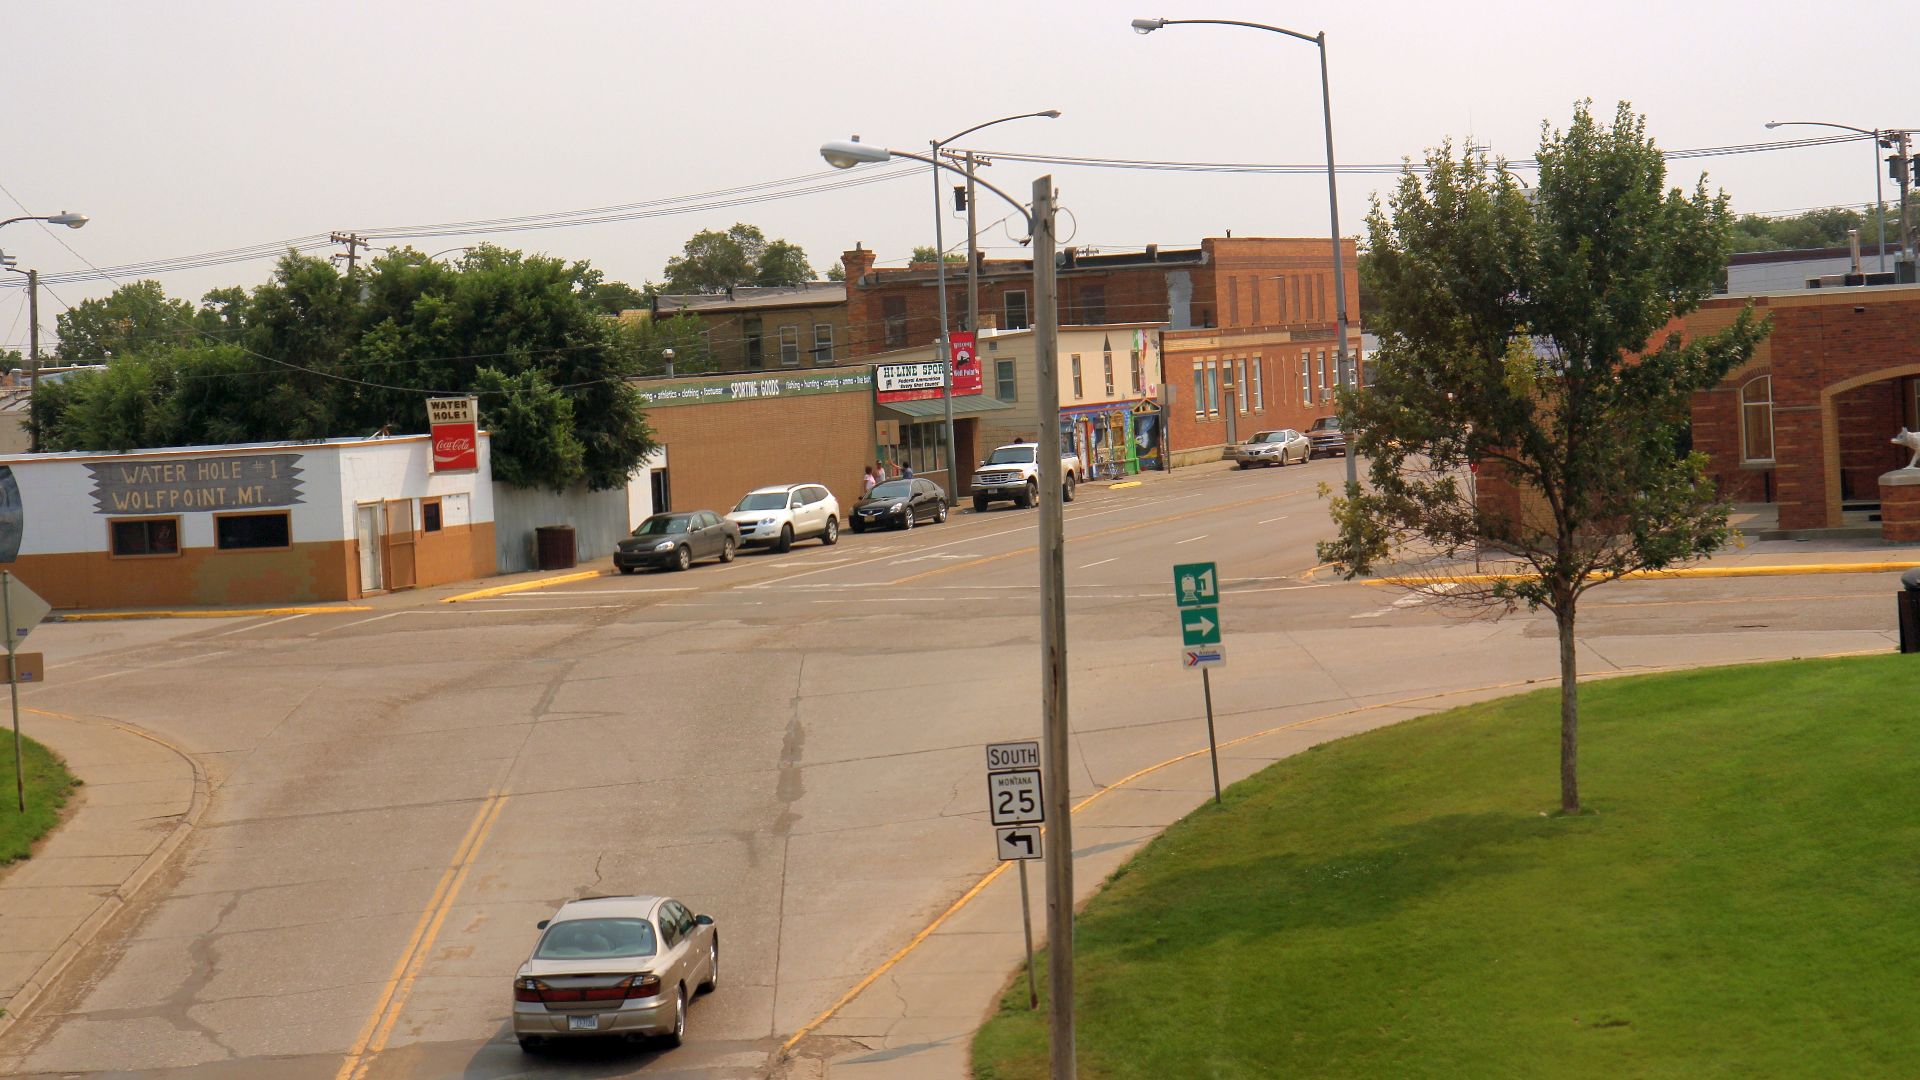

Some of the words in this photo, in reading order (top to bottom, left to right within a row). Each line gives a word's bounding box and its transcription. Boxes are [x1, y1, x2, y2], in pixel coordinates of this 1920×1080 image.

[730, 381, 758, 399] SPORTING
[760, 379, 780, 397] GOODS
[430, 400, 468, 410] WATER
[433, 411, 460, 420] HOLE
[121, 465, 187, 485] WATER
[198, 461, 242, 481] HOLE
[990, 748, 1037, 766] SOUTH
[998, 777, 1032, 787] MONTANA
[998, 789, 1035, 815] 25
